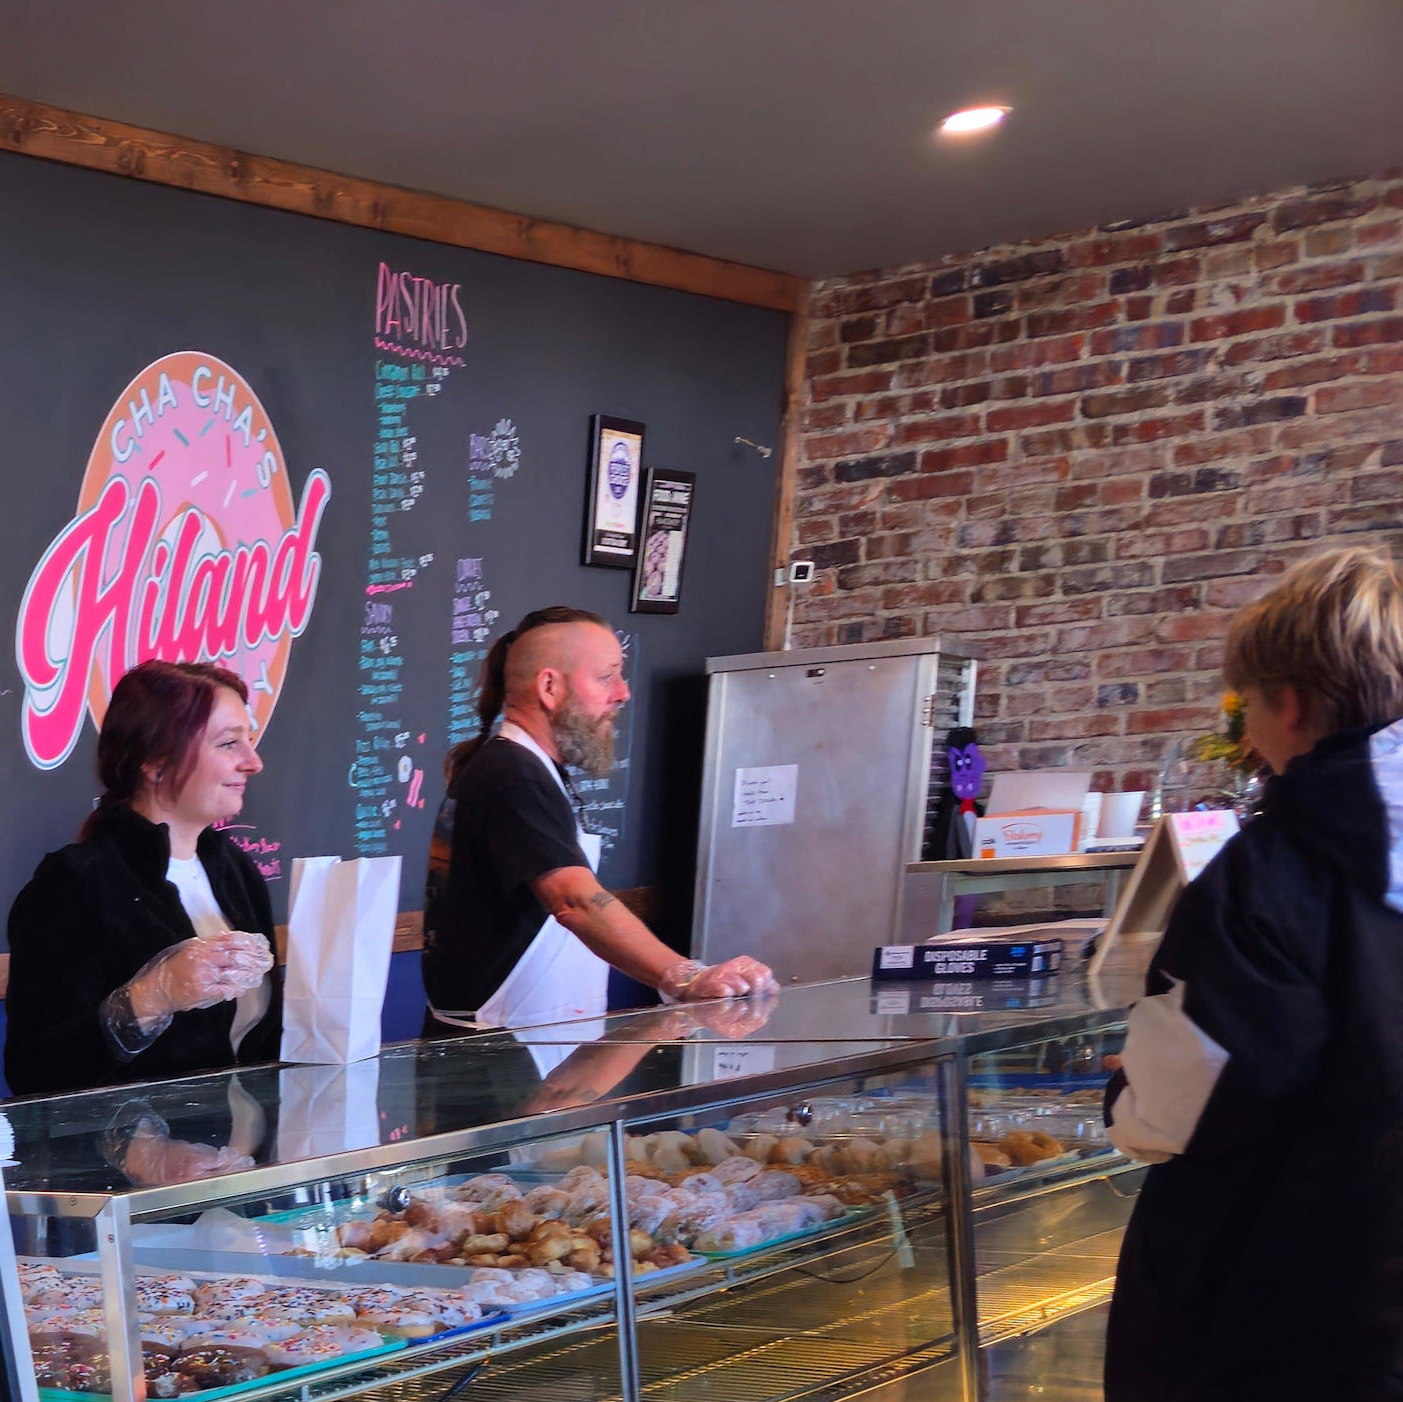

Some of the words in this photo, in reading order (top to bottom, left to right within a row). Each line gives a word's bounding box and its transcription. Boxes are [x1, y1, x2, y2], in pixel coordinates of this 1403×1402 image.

[375, 262, 467, 350] PASTRIES
[111, 372, 178, 463] CHA
[192, 366, 277, 489] CHA'S
[17, 468, 332, 770] Hiland
[924, 949, 988, 962] DISPOSABLE
[934, 961, 975, 974] GLOVES
